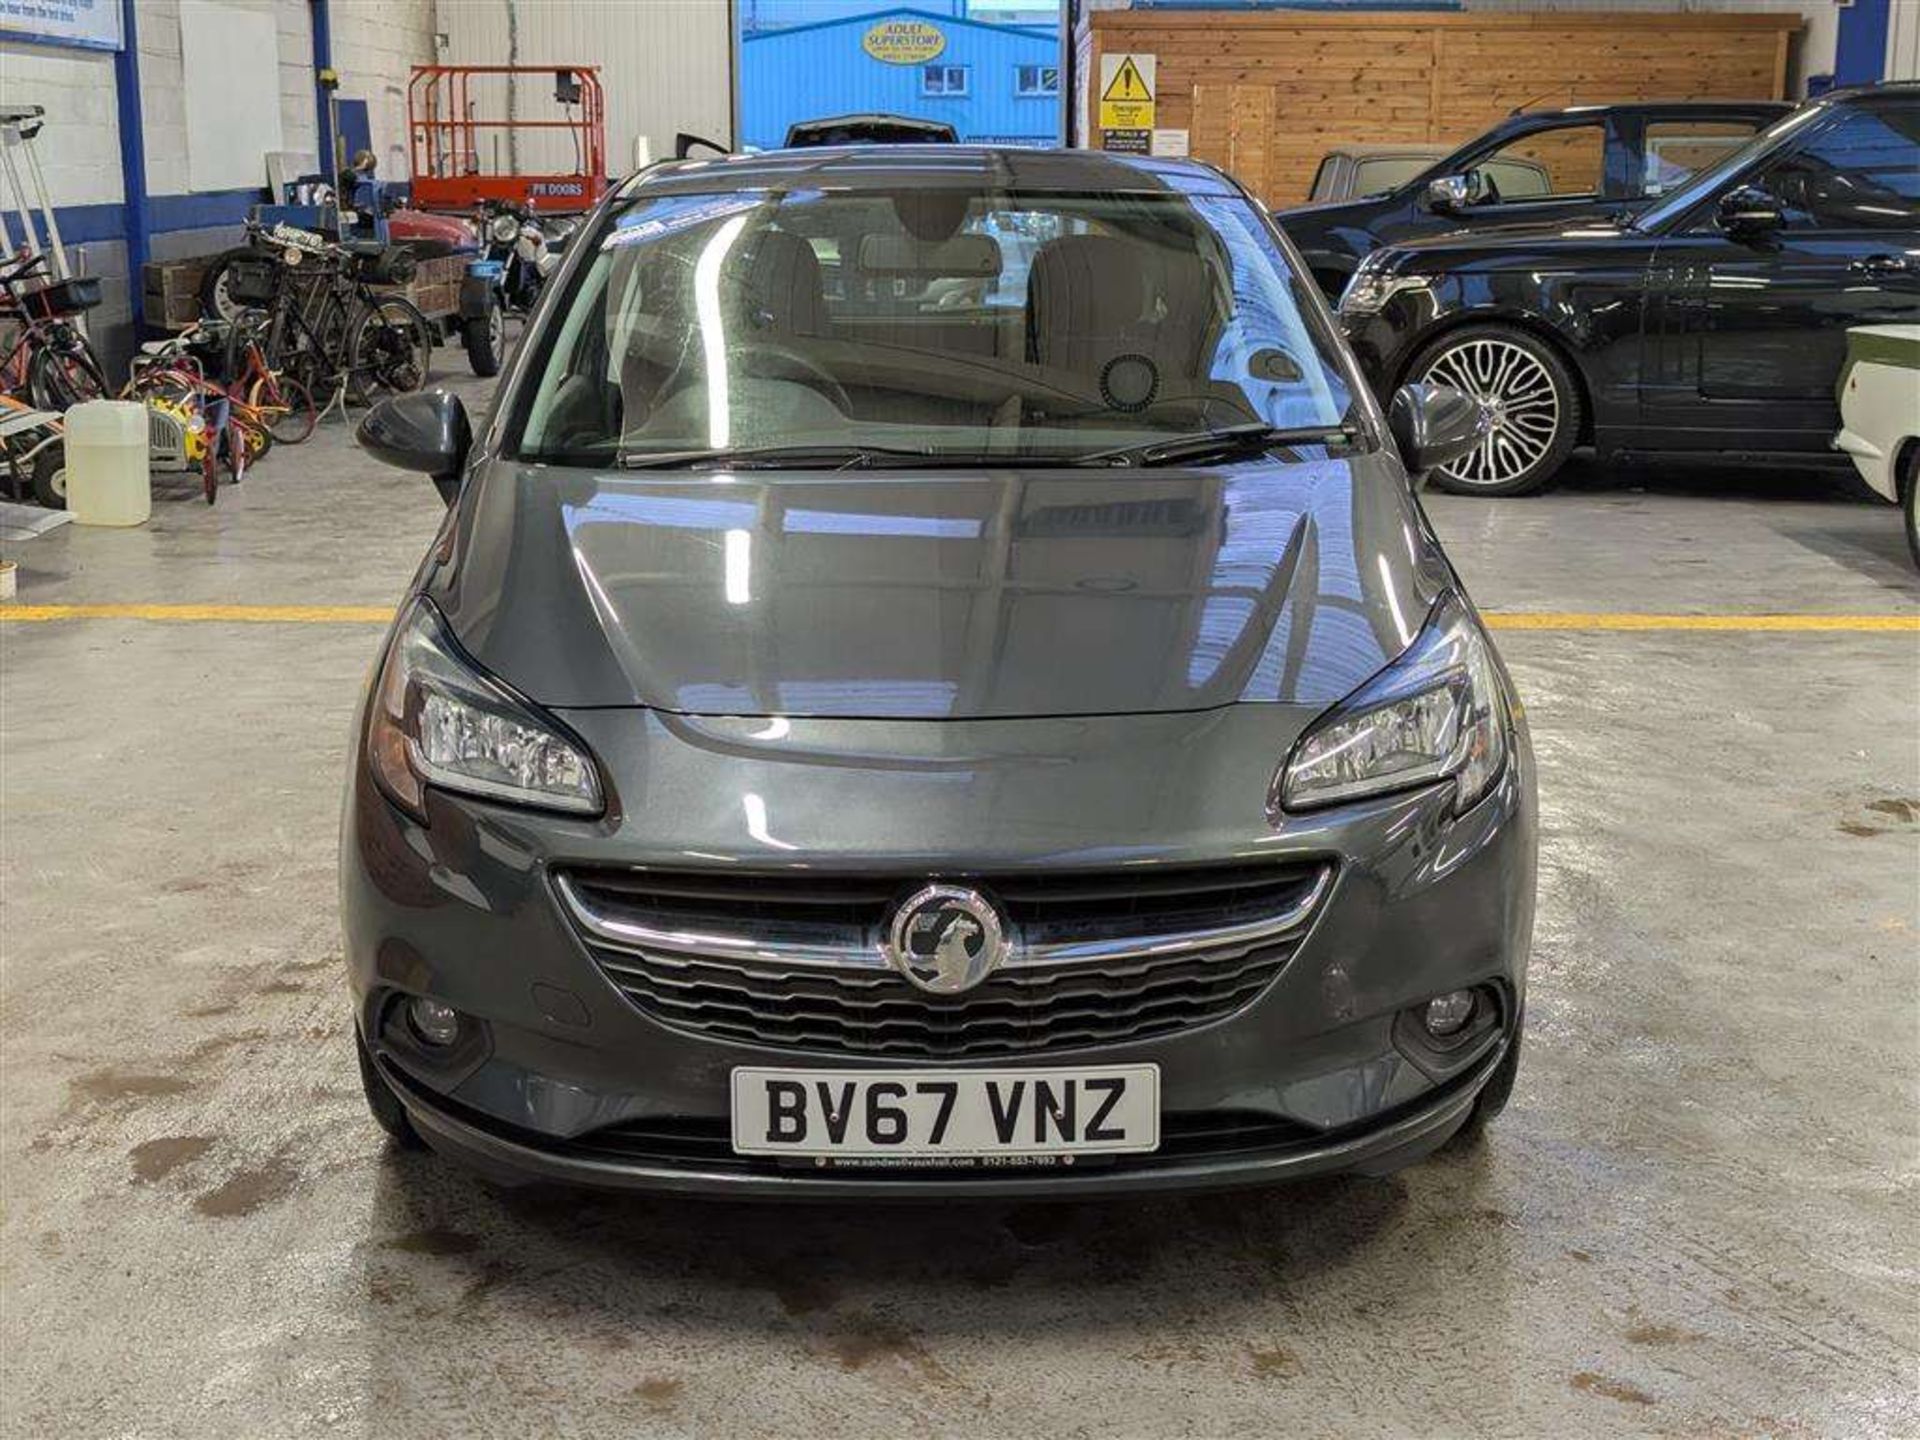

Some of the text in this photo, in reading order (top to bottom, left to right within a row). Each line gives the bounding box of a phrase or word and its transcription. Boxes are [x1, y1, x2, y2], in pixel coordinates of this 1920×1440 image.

[869, 33, 939, 46] SUPERSTORE
[548, 183, 583, 196] DOORS
[766, 1078, 1126, 1144] BV67 VNZ
